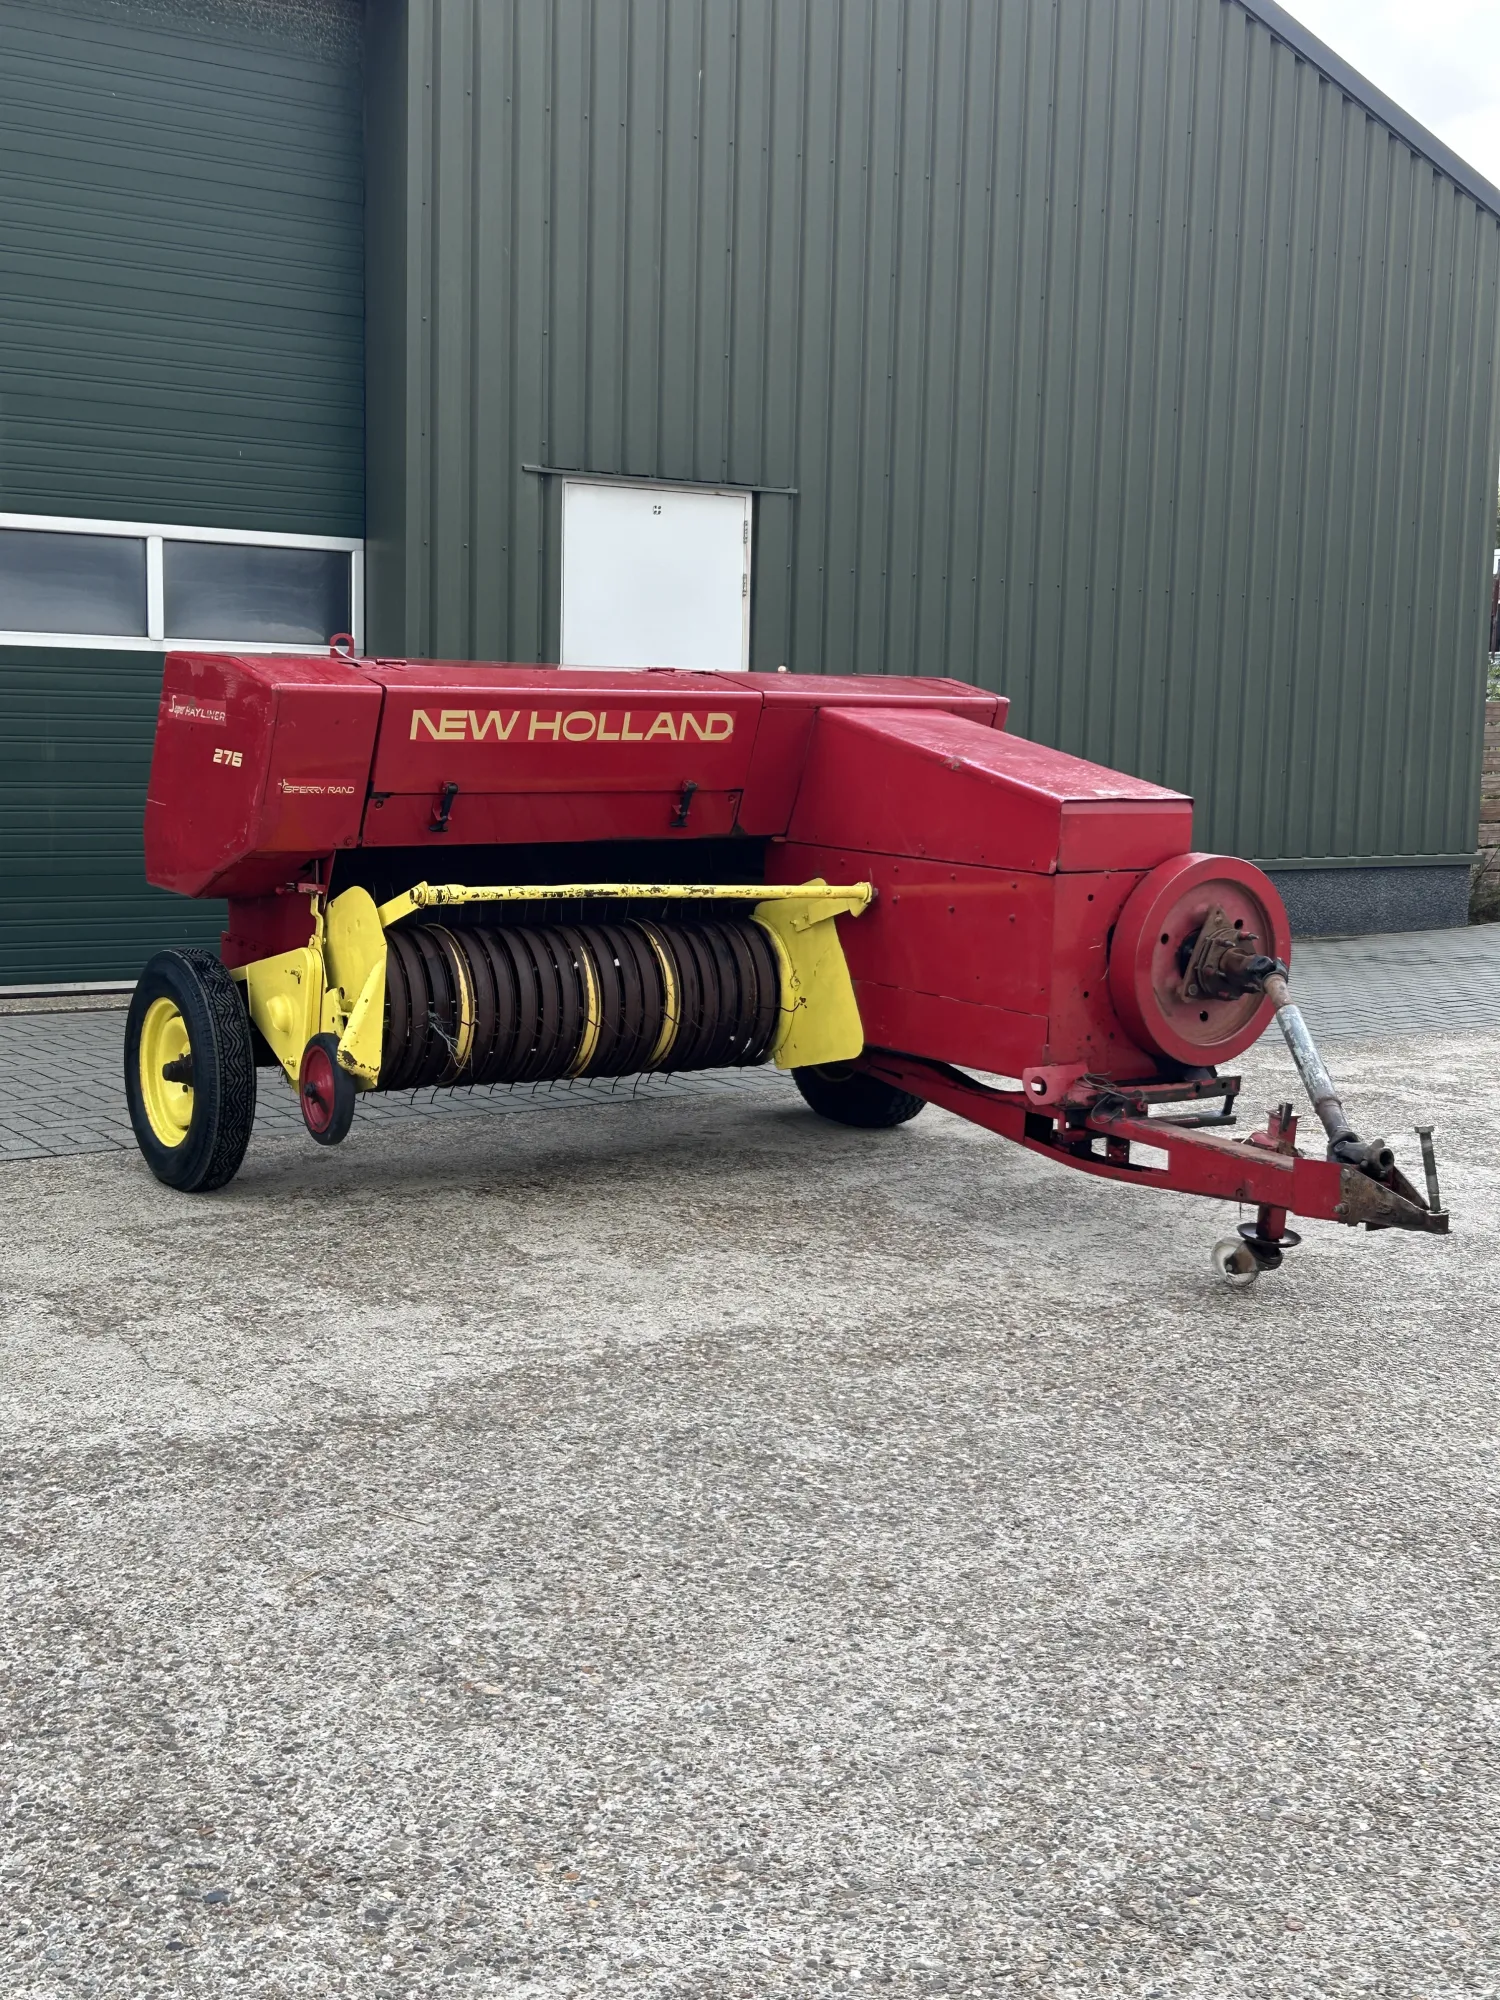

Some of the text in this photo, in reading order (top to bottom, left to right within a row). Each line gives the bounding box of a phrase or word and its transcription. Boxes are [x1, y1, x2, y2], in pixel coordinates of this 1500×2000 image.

[409, 709, 734, 741] NEW HOLLAND
[212, 748, 243, 768] 276
[283, 786, 355, 794] SPERRY RAND
